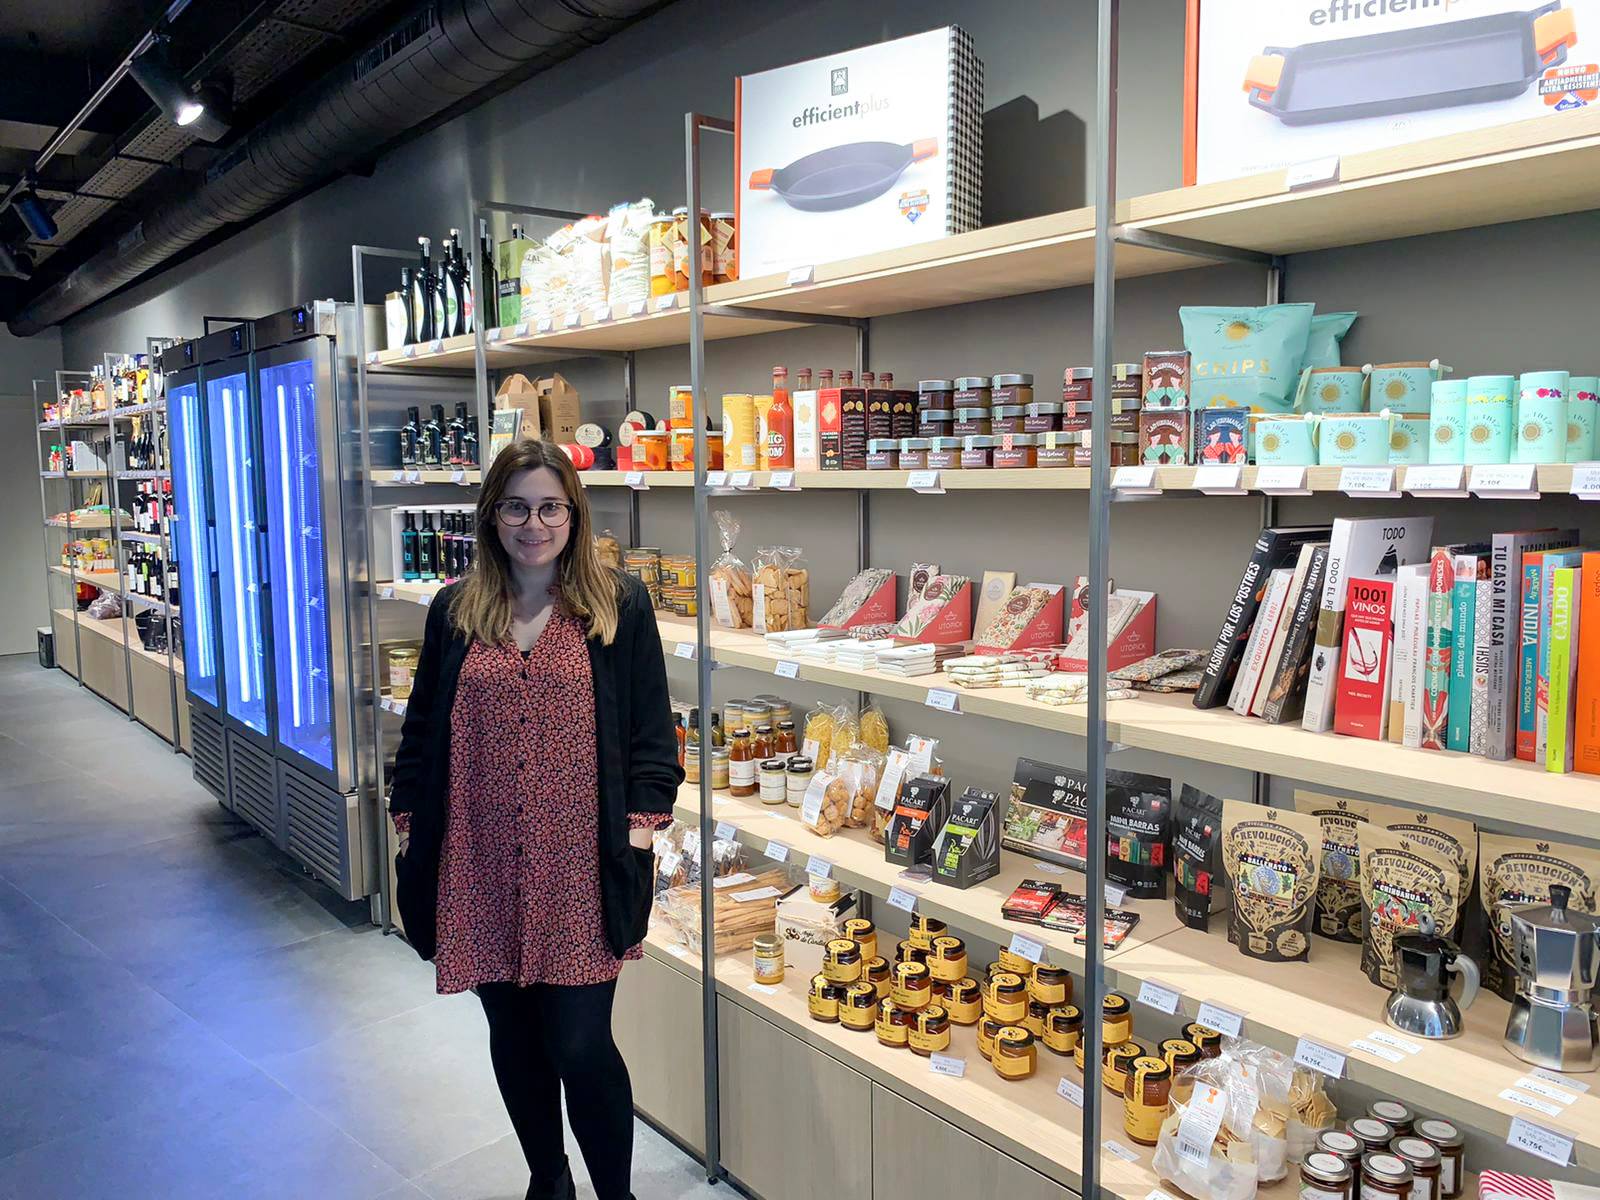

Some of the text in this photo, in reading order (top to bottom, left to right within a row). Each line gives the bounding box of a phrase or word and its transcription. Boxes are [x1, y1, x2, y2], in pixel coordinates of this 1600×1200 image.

[1195, 357, 1272, 378] CHIPS
[768, 447, 783, 457] OM
[1382, 527, 1405, 540] TODO
[1306, 554, 1323, 590] COMER
[1329, 557, 1341, 584] TODO
[1235, 561, 1260, 605] POSTRES
[1327, 586, 1336, 597] EL
[1353, 586, 1387, 604] 1001
[1491, 545, 1507, 646] TU CASA MI CASA
[1227, 603, 1243, 623] LOS
[1297, 591, 1313, 623] SETAS
[1352, 601, 1386, 615] VINOS
[1555, 586, 1569, 640] CALDO
[938, 622, 963, 631] UTOPICK
[1220, 622, 1236, 643] POR
[1522, 603, 1539, 646] INDIA
[1030, 631, 1055, 640] UTOPICK
[1456, 601, 1468, 678] platos del mundo
[1120, 643, 1146, 652] UTOPICK
[1251, 628, 1269, 672] EXQUISITO
[1431, 649, 1440, 666] CON
[1475, 645, 1489, 675] SUSHI
[1430, 665, 1438, 697] COCINAR
[1524, 656, 1533, 714] MEERA SODHA
[1110, 815, 1128, 825] MINI
[1129, 818, 1160, 832] BARRAS
[1240, 831, 1299, 852] REVOLUCIÓN
[1247, 857, 1288, 872] BALLENATO
[1377, 857, 1435, 883] REVOLUCIÓN
[1505, 862, 1580, 888] REVOLUCIÓN
[1379, 884, 1421, 902] CHIHUAHUA
